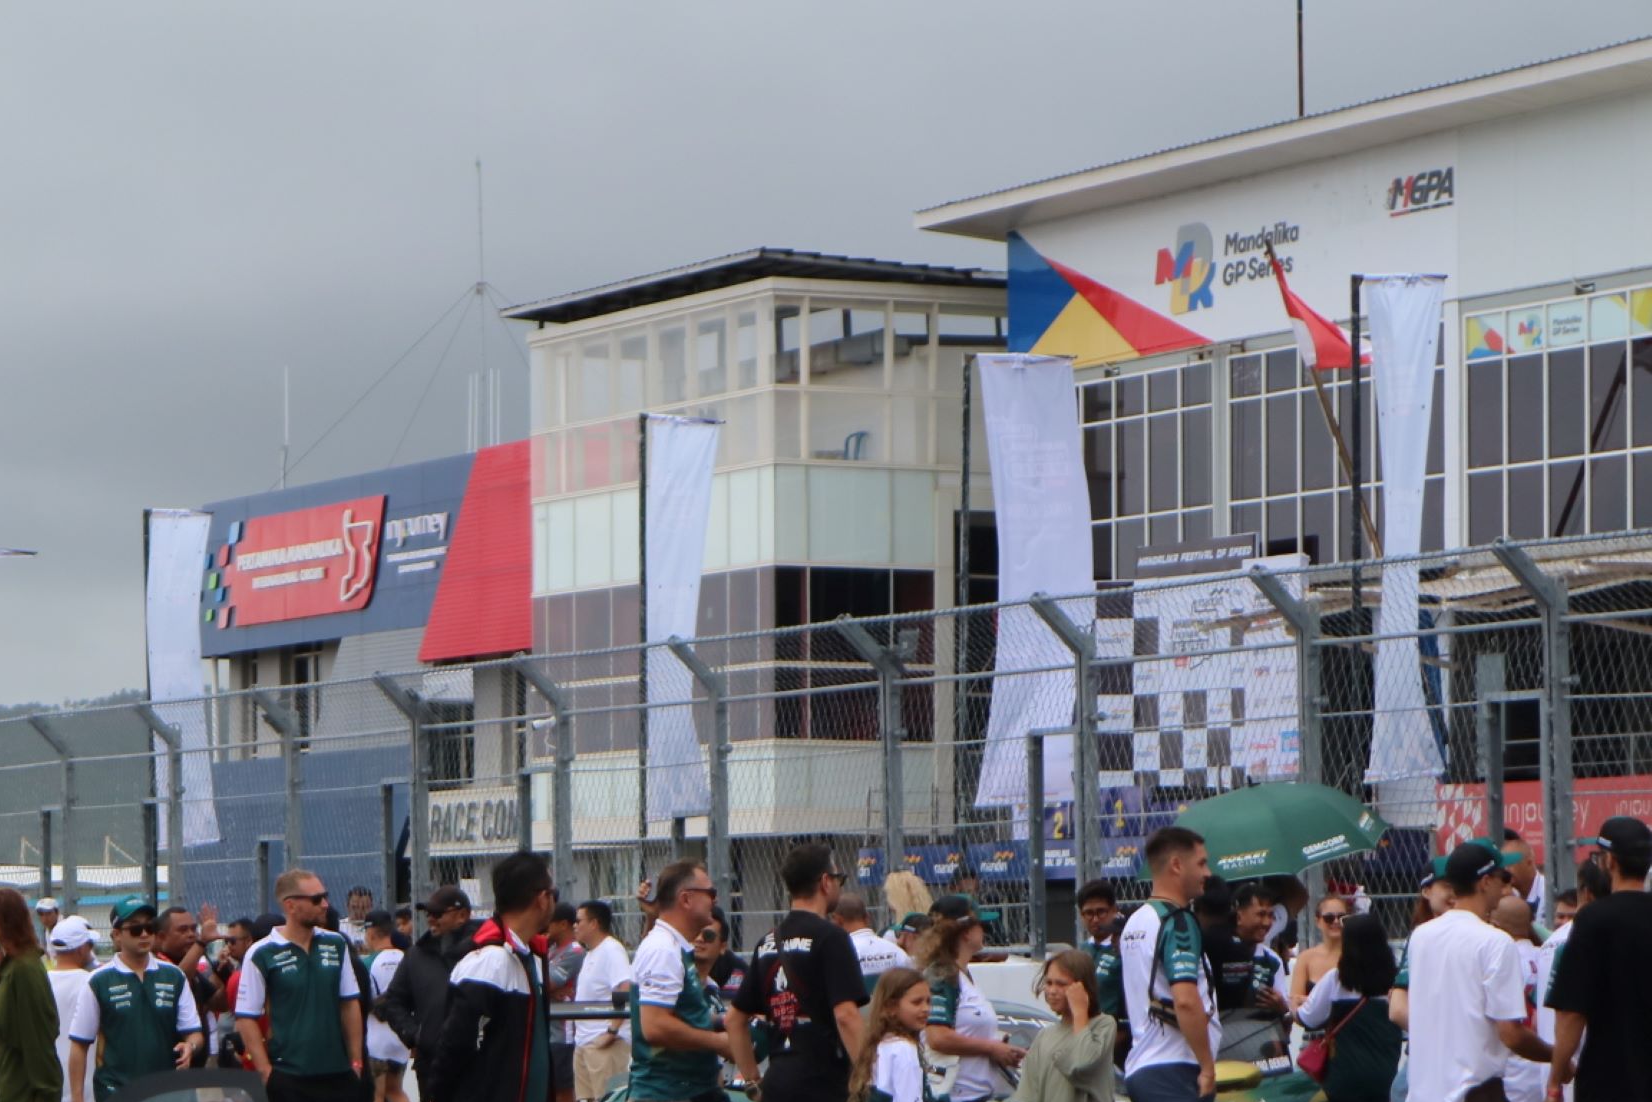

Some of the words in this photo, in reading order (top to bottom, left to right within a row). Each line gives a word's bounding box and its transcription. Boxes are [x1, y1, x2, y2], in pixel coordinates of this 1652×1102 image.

[1388, 167, 1454, 210] MGPA
[1224, 220, 1300, 256] Mandalika
[1222, 260, 1246, 286] GP
[430, 801, 477, 843] RACE
[1053, 812, 1064, 839] 2
[1223, 857, 1265, 871] RACING
